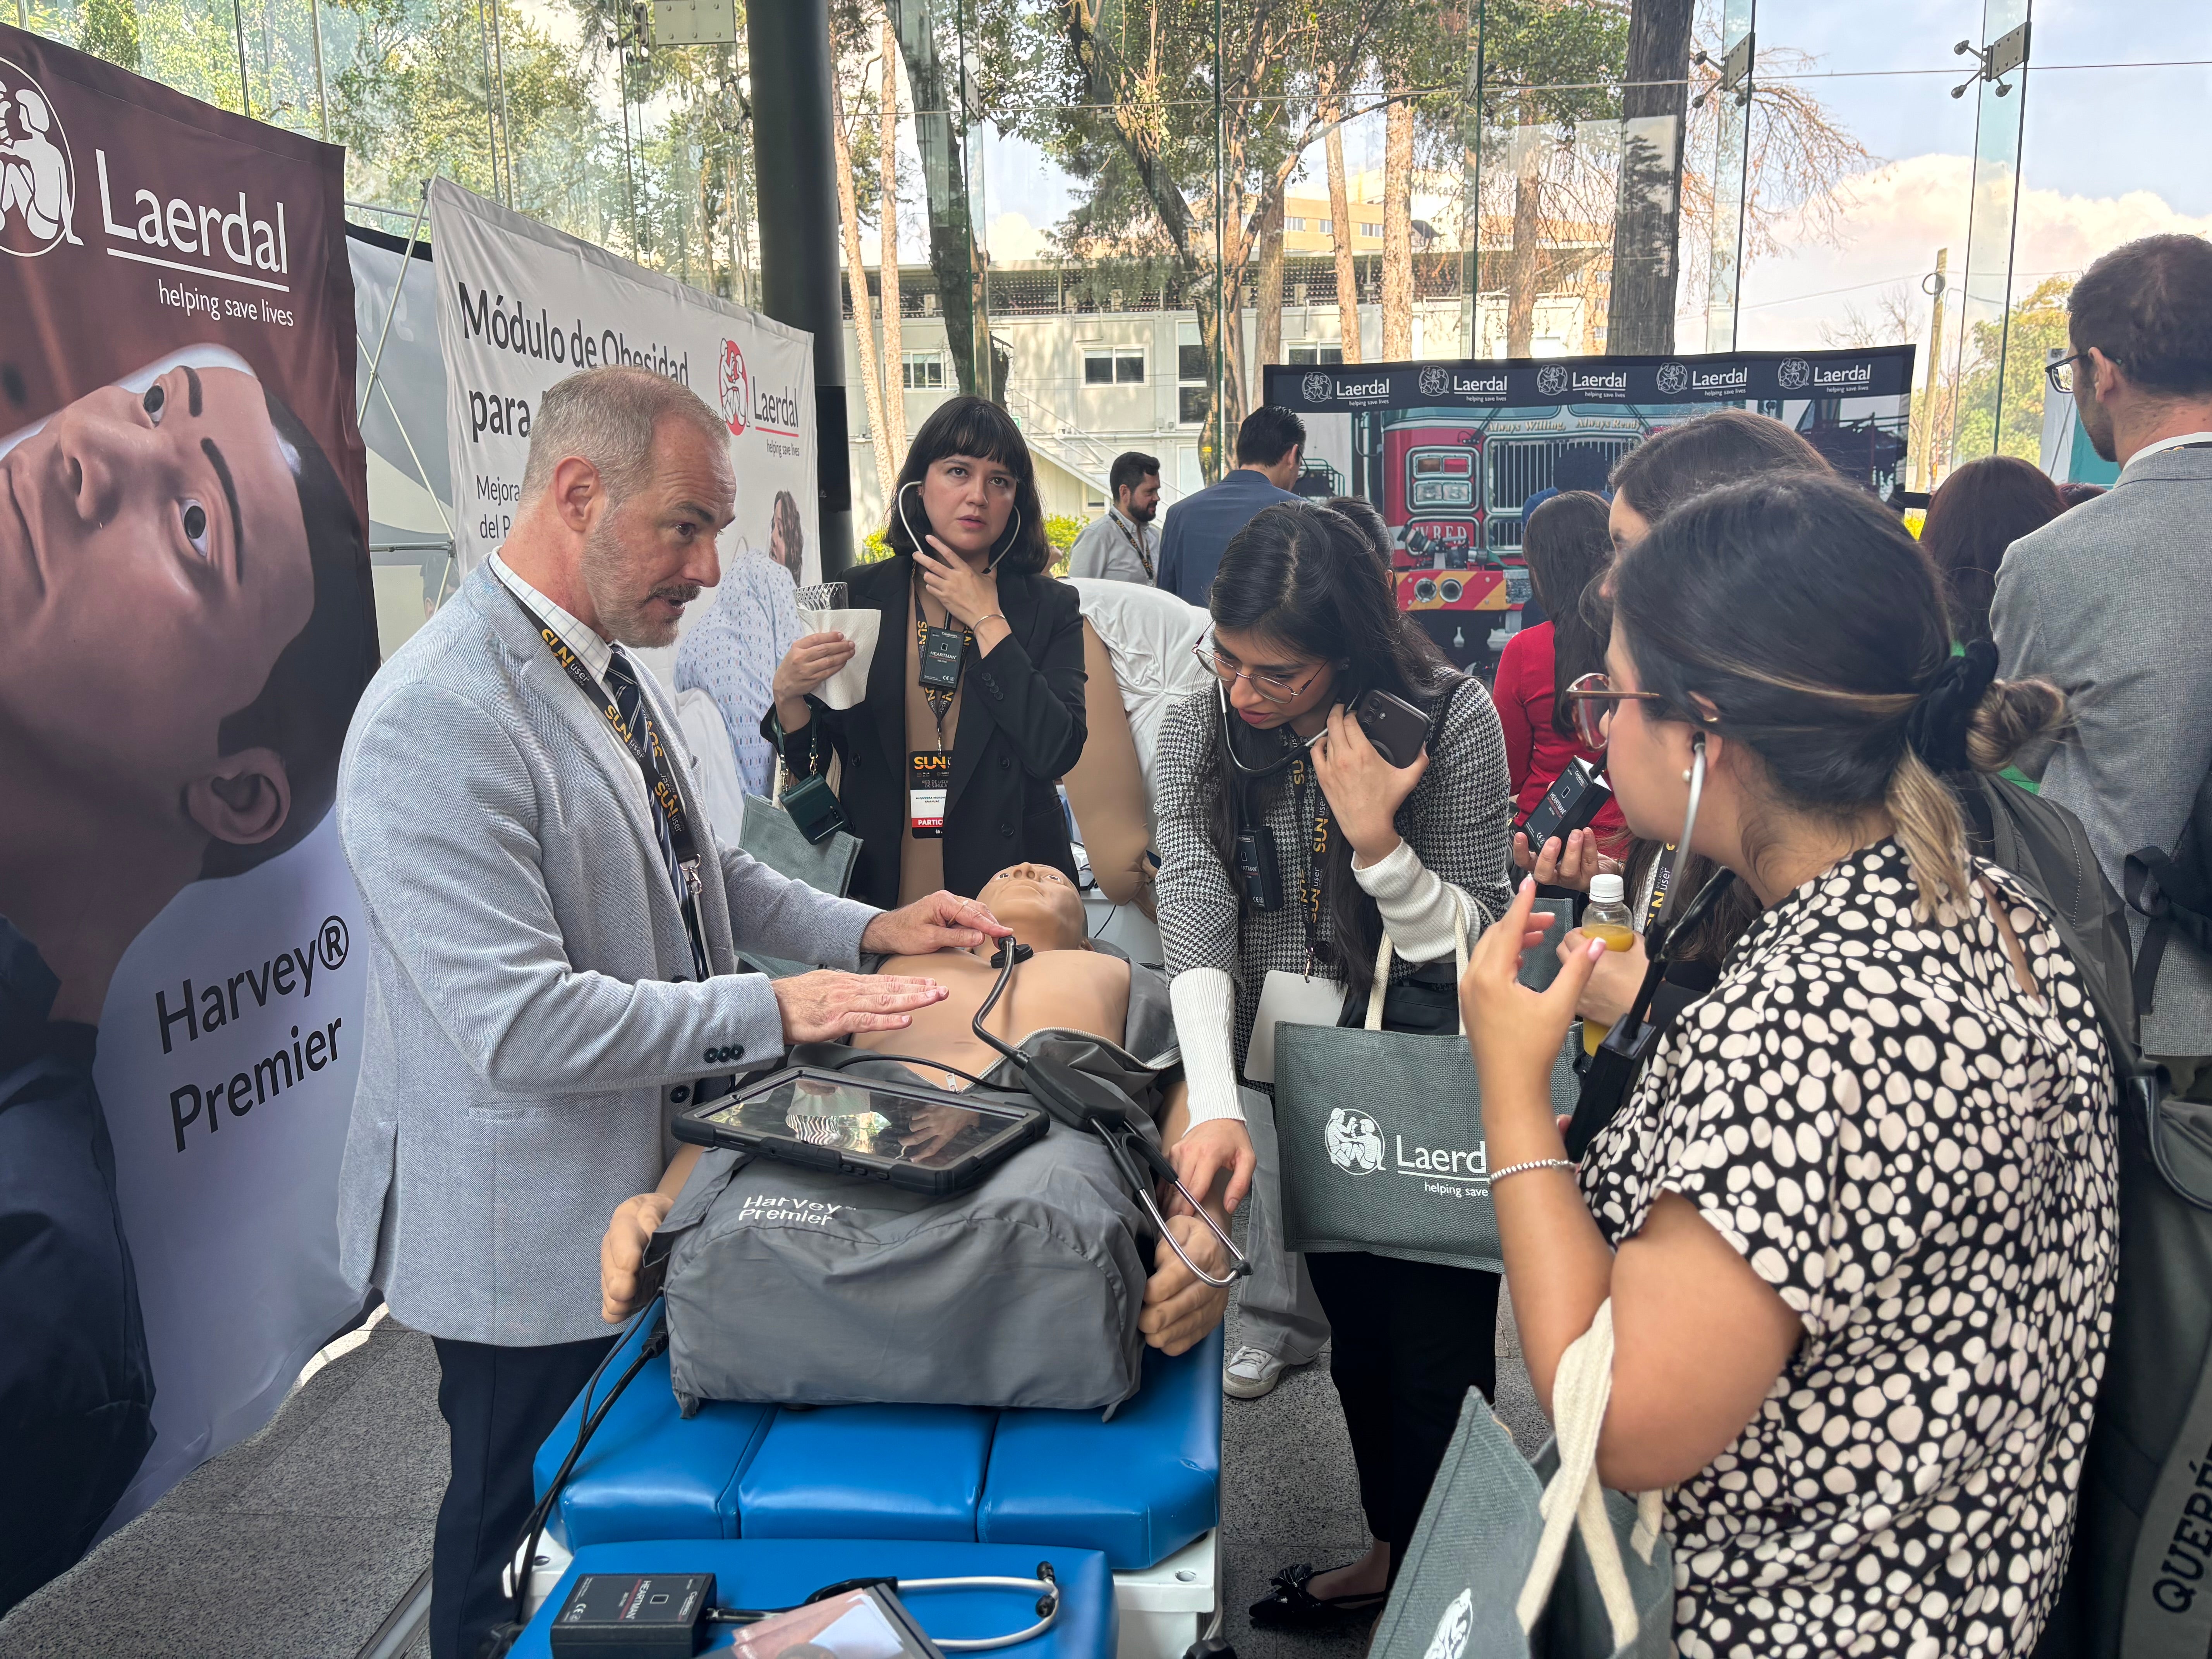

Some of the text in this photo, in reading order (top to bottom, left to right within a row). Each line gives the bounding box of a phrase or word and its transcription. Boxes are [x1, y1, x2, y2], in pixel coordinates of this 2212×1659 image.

[95, 148, 288, 274] Laerdal
[159, 279, 294, 327] helping save lives
[459, 282, 565, 364] Módulo
[571, 319, 597, 369] de
[1454, 376, 1507, 391] Laerdal
[1573, 372, 1626, 387] Laerdal
[1692, 367, 1747, 386] Laerdal
[1814, 364, 1871, 382] Laerdal
[1337, 378, 1389, 396] Laerdal
[752, 376, 799, 428] Laerdal
[469, 390, 531, 443] para
[1486, 418, 1641, 433] Always Willing, Always Ready
[766, 439, 800, 458] helping save lives
[476, 474, 520, 506] Mejora
[480, 514, 500, 539] del
[918, 621, 927, 645] SUN
[542, 629, 575, 668] SUN
[571, 663, 589, 682] user
[930, 651, 957, 660] HEARTMAN
[604, 705, 632, 743] SUN
[630, 740, 644, 758] user
[1289, 732, 1298, 748] user
[914, 756, 946, 770] SUN
[1292, 759, 1304, 785] SU
[654, 781, 682, 832] SUN user
[1549, 792, 1567, 815] HEARTMAN
[1313, 818, 1329, 853] SUN
[1660, 867, 1670, 890] user
[156, 915, 349, 1054] Harvey®
[170, 1017, 342, 1153] Premier
[1396, 1135, 1487, 1174] Laerd
[1425, 1181, 1489, 1198] helping save
[738, 1208, 833, 1226] Premier
[743, 1195, 843, 1214] Harvey
[2152, 1441, 2212, 1615] QUER
[625, 1580, 652, 1620] HEARTMAN
